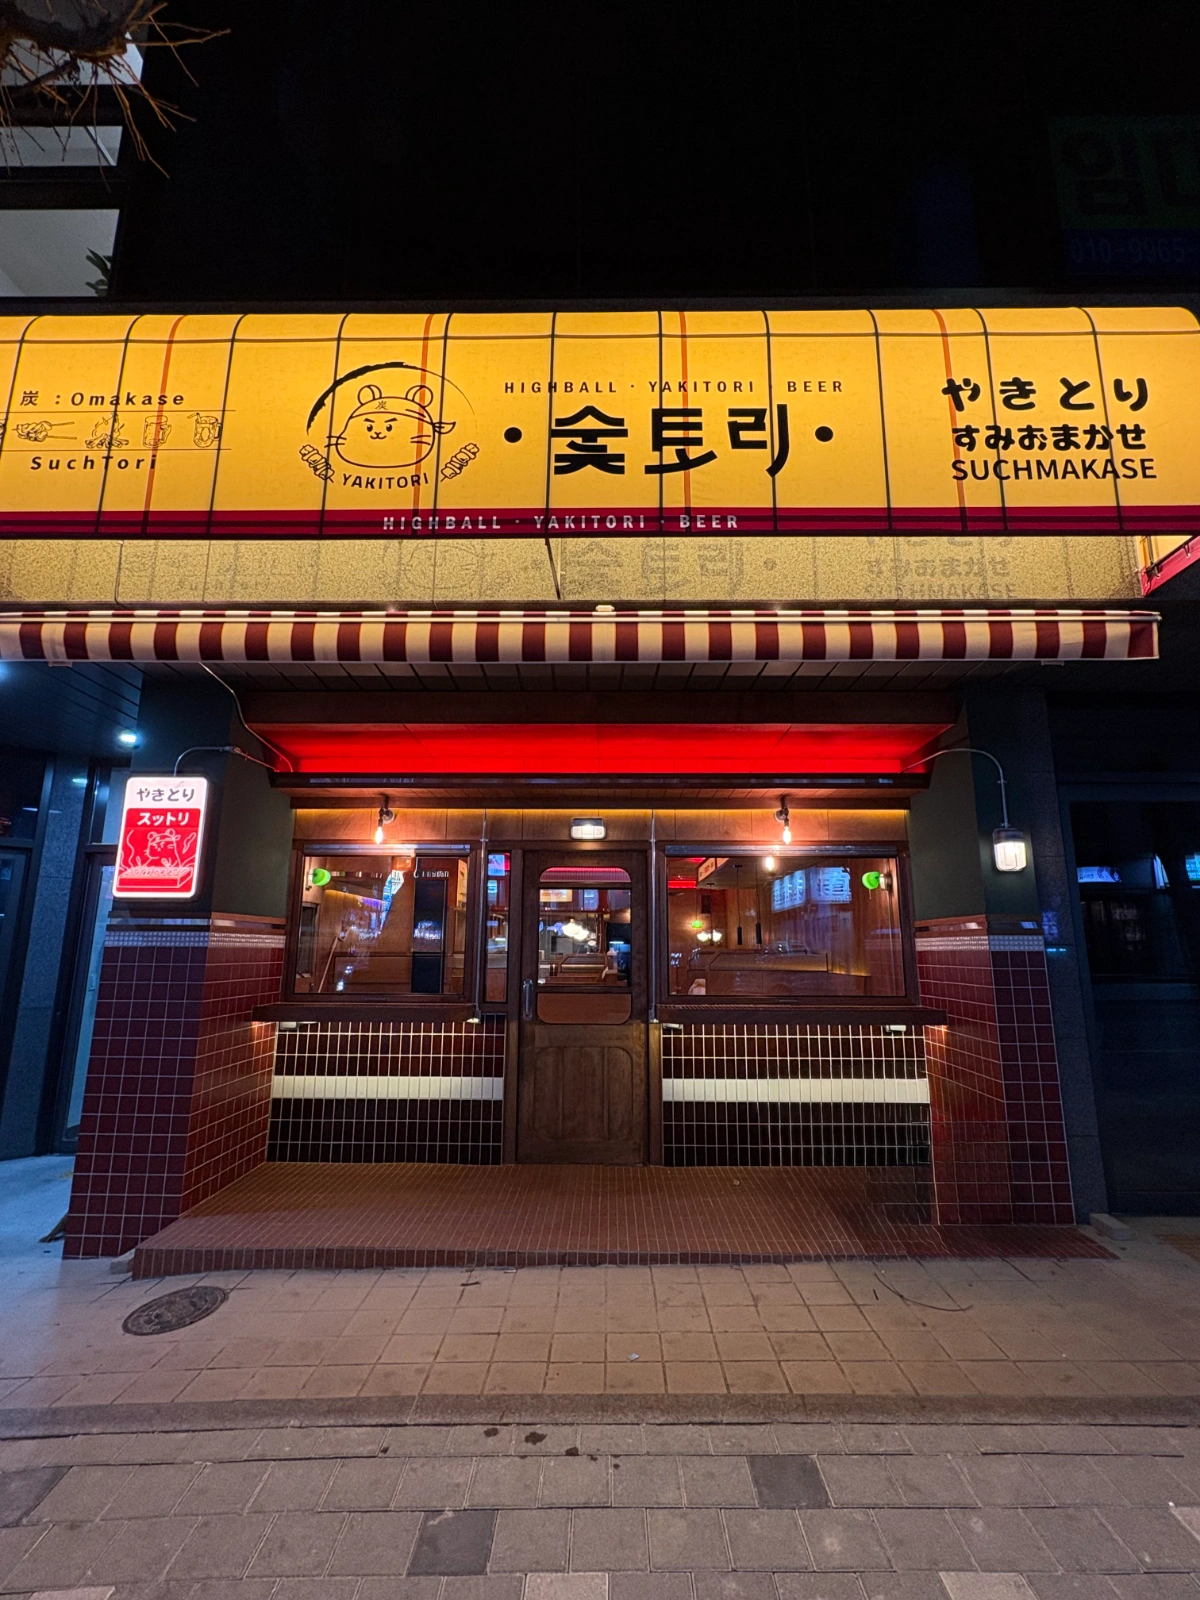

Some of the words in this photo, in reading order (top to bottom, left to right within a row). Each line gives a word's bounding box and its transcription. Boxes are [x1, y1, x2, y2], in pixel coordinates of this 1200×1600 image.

[504, 381, 617, 393] HIGHBALL
[649, 380, 753, 393] YAKITORI
[787, 380, 843, 393] BEER
[941, 376, 1149, 412] やきとり
[70, 392, 185, 406] Omakase
[951, 423, 1147, 452] すみおまかせ
[30, 453, 157, 471] SuchTori
[951, 458, 1158, 480] SUCHMAKASE
[342, 473, 429, 489] YAKITORI
[383, 516, 501, 530] HIGHBALL
[534, 515, 646, 529] YAKITORI
[679, 515, 739, 529] BEER
[136, 788, 195, 802] やきとり
[136, 812, 190, 826] スットリ
